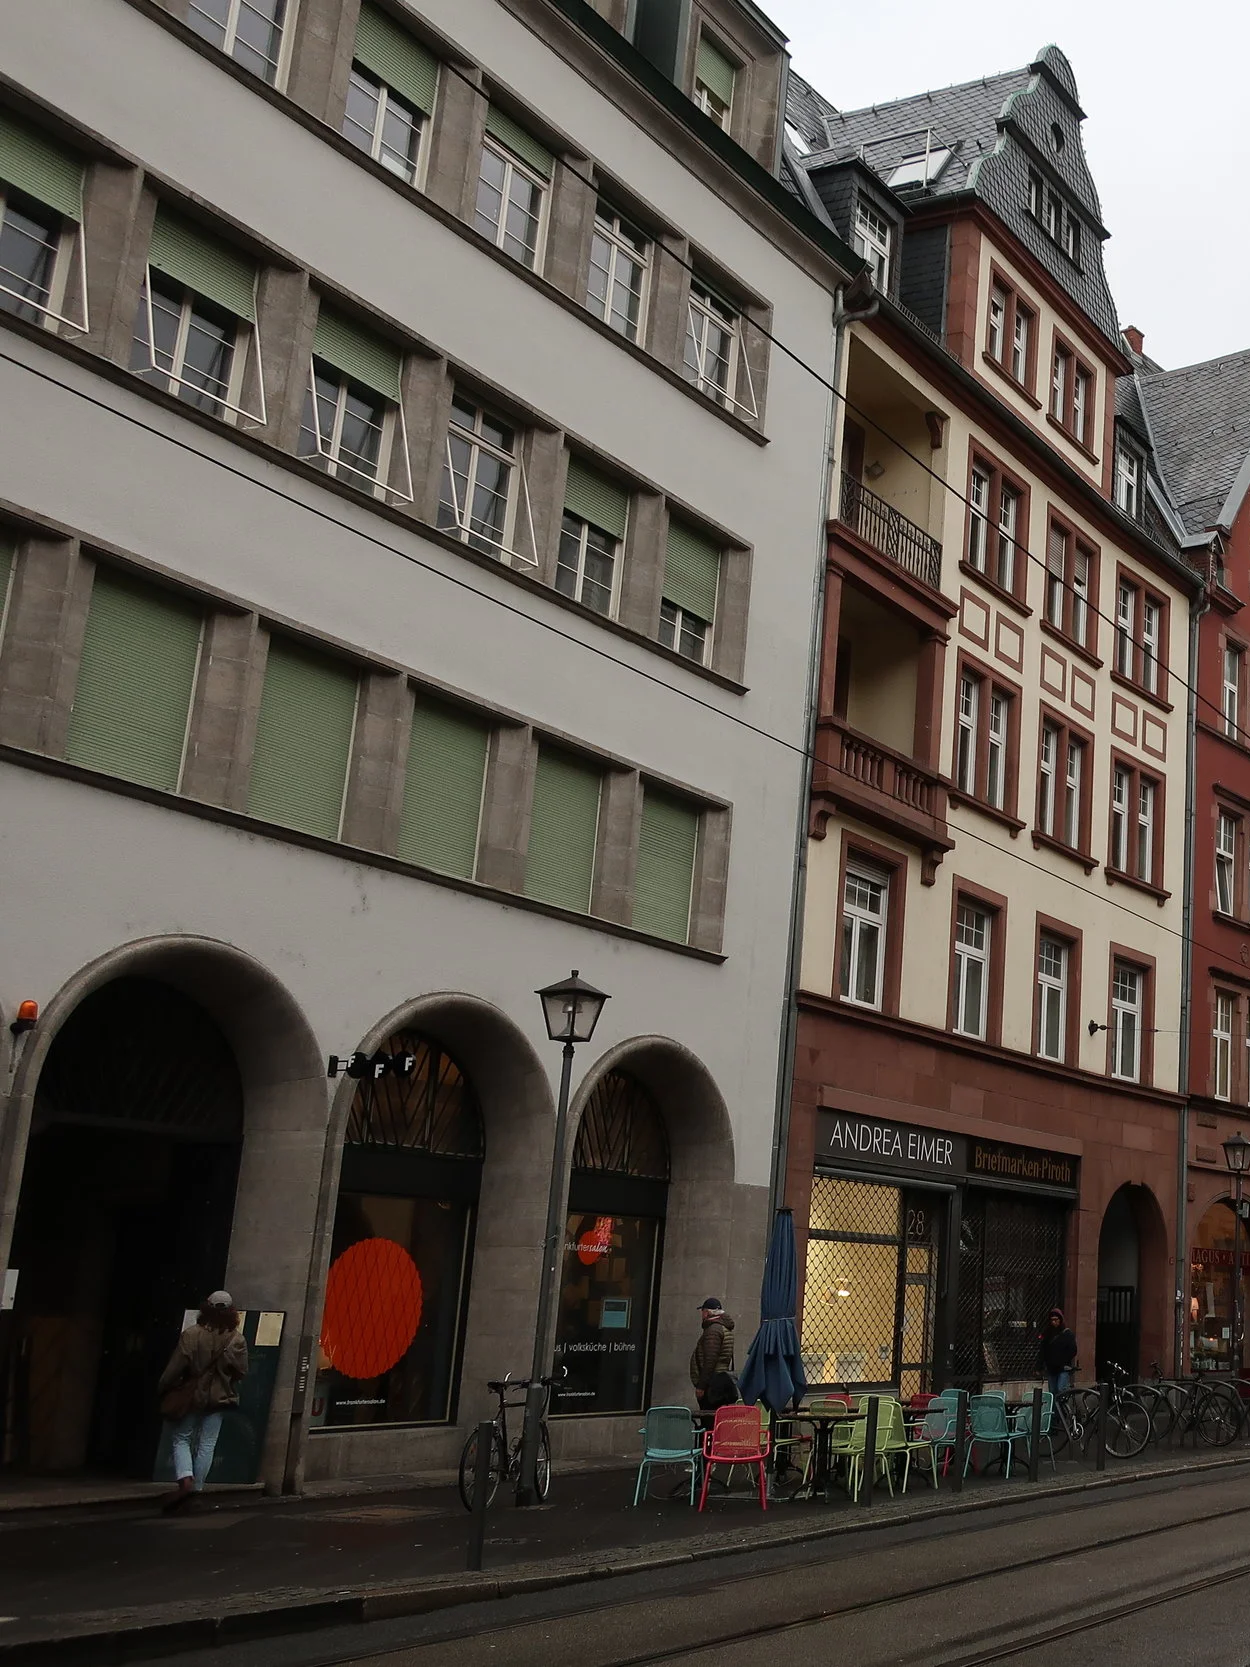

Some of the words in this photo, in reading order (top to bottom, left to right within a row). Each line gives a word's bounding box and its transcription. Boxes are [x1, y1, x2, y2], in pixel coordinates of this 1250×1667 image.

[348, 1055, 356, 1068] F
[374, 1063, 385, 1079] F
[404, 1056, 414, 1072] F
[830, 1120, 903, 1157] ANDREA
[908, 1133, 953, 1166] EIMER
[907, 1209, 925, 1236] 28
[569, 1342, 607, 1352] volksküche
[614, 1342, 636, 1352] bühne
